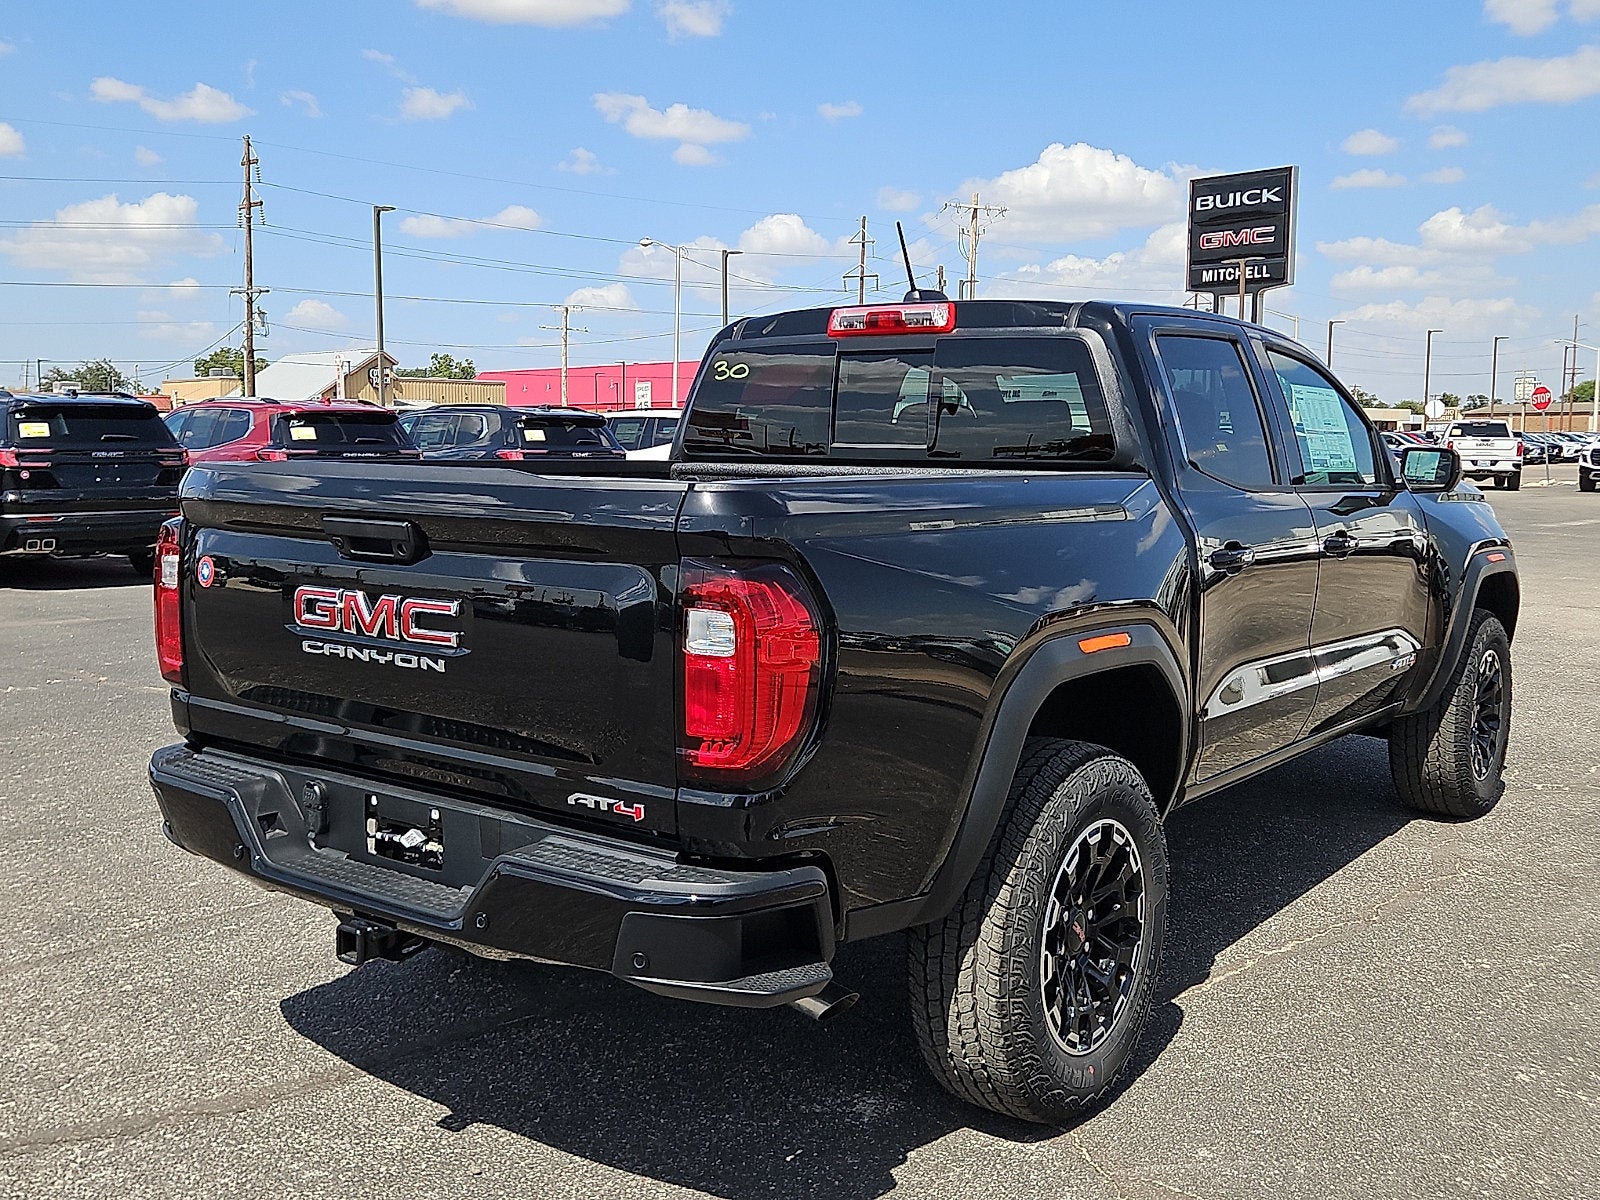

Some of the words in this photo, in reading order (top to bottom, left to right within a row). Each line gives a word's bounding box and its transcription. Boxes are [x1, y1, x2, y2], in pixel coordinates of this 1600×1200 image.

[1196, 186, 1282, 211] BUICK
[1199, 226, 1275, 249] GMC
[1202, 265, 1270, 282] MITCHELL
[714, 360, 749, 380] 30
[1532, 392, 1551, 405] STOP
[294, 584, 463, 650] GMC
[302, 640, 446, 673] CANYON
[567, 792, 646, 822] AT4
